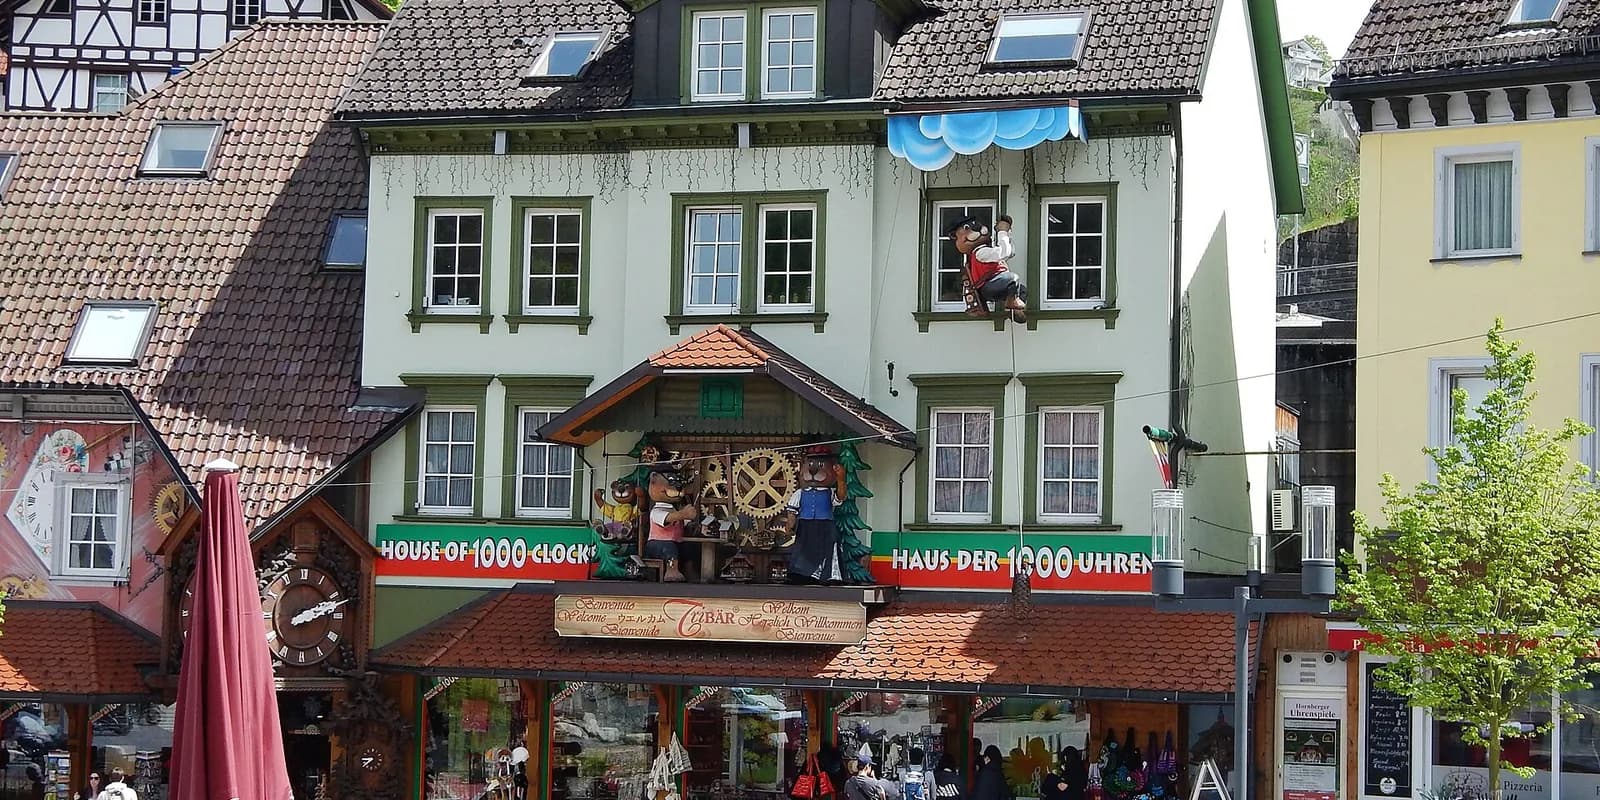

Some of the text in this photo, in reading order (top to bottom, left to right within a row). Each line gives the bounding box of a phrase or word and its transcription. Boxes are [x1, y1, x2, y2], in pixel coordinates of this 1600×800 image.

[381, 540, 440, 561] HOUSE
[445, 541, 470, 562] OF
[472, 537, 528, 569] 1000
[892, 548, 950, 571] HAUS
[957, 550, 999, 572] DER
[1007, 546, 1073, 579] 1000
[575, 597, 635, 611] Benvenuto
[762, 601, 810, 615] Welkom
[557, 609, 608, 623] Welcome
[738, 613, 864, 631] Herzlich Willkommen
[601, 623, 660, 637] Bienvenido
[775, 627, 836, 641] Bienvenue
[1290, 709, 1336, 719] Uhrenspiele
[1295, 703, 1330, 711] Hornberger
[1503, 780, 1543, 792] Pizzeria
